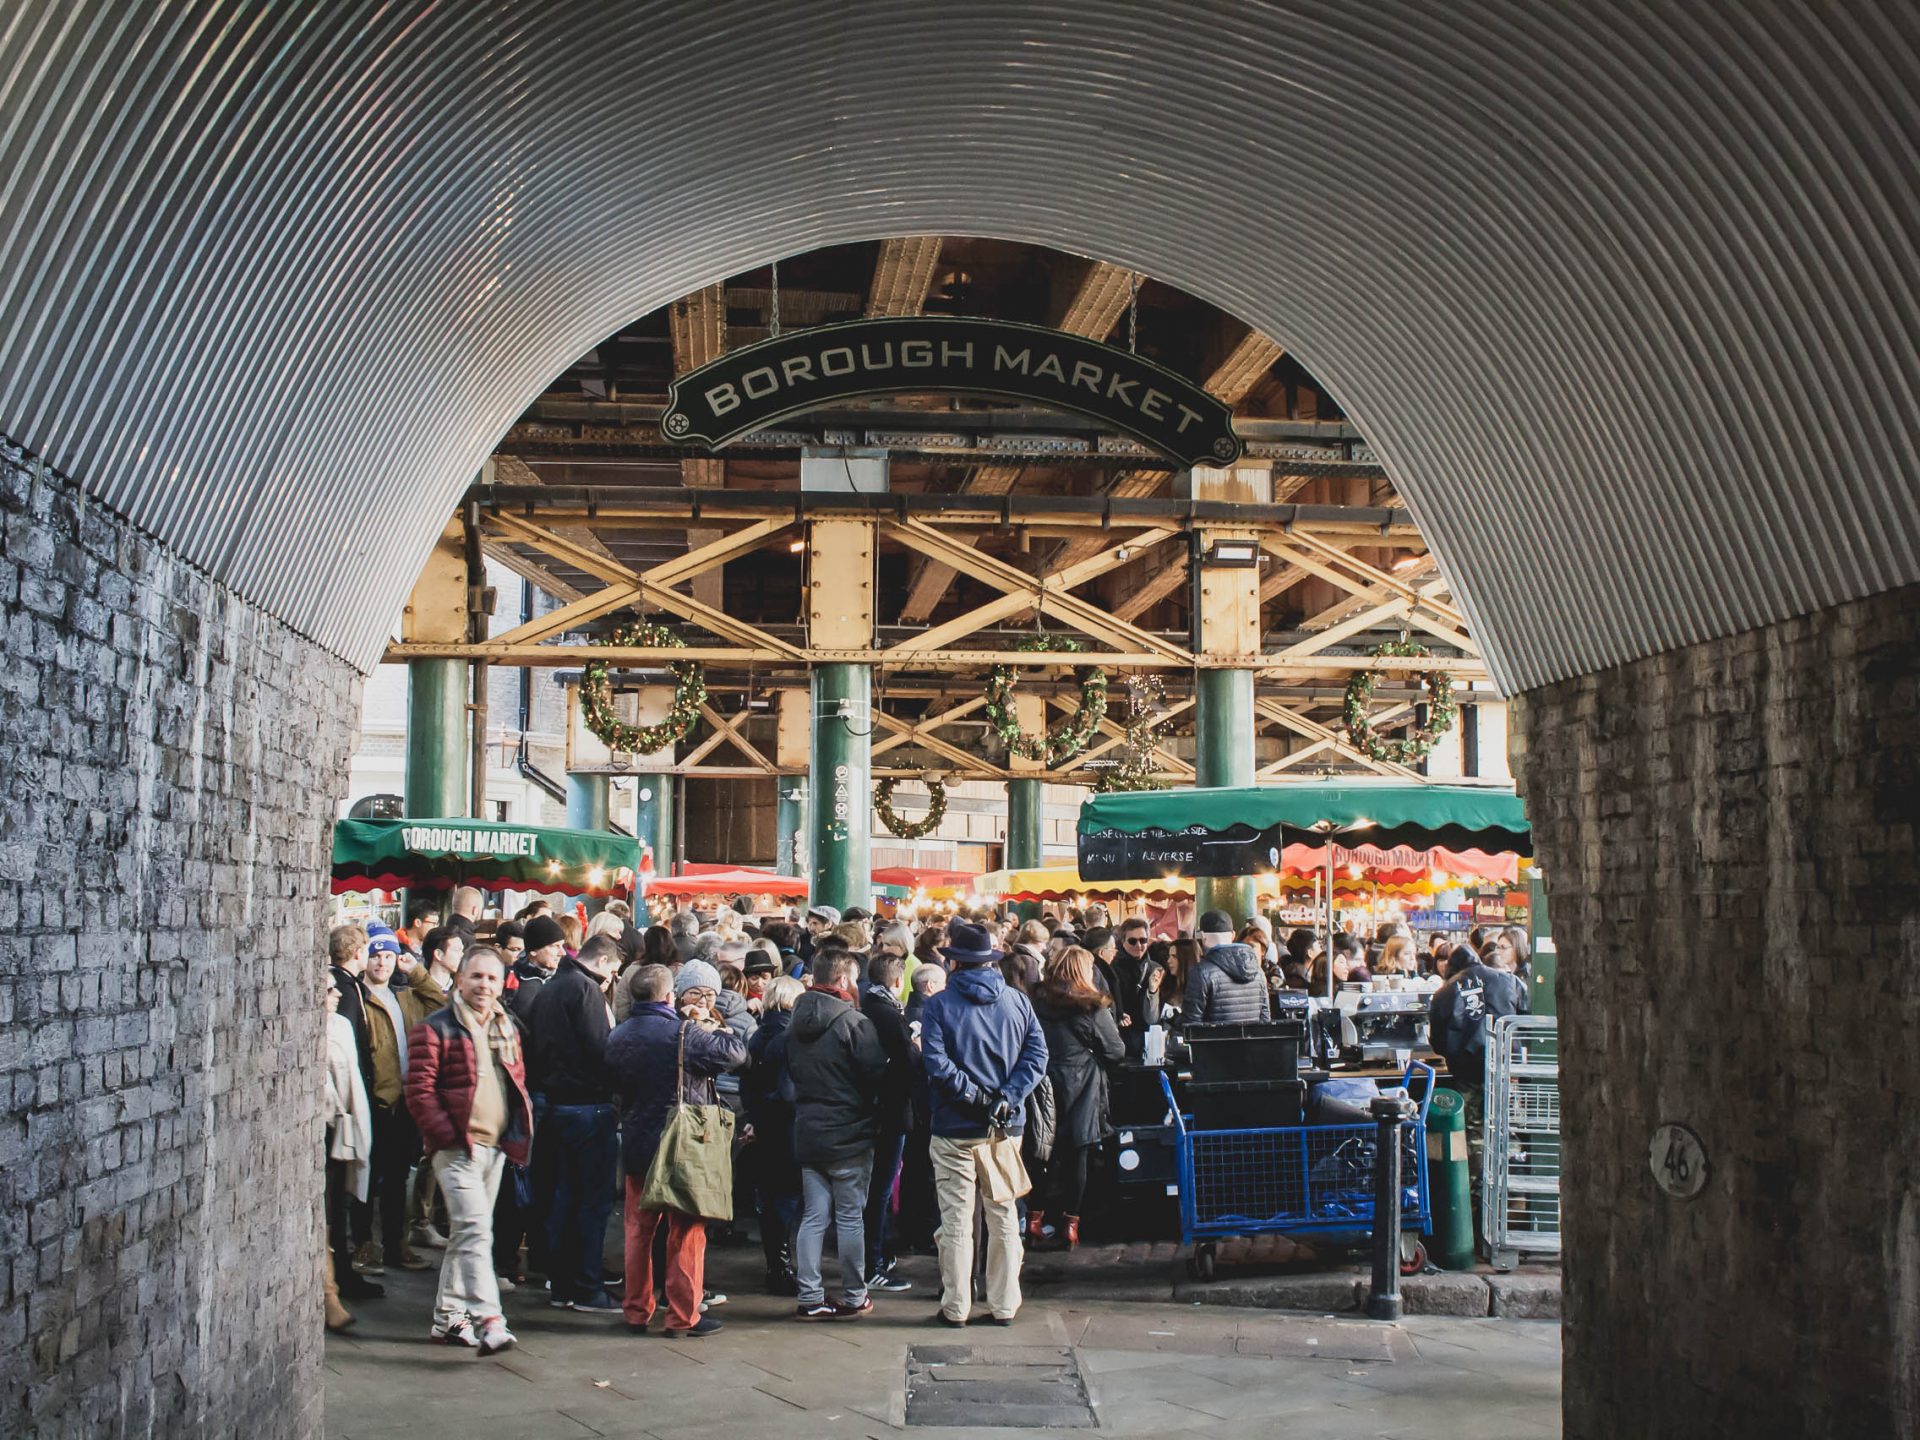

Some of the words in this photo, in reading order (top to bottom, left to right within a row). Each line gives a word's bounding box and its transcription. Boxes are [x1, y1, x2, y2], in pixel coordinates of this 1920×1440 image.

[704, 339, 975, 419] BOROUGH
[993, 344, 1204, 435] MARKET
[401, 826, 472, 853] BOROUGH
[473, 830, 539, 856] MARKET
[1086, 853, 1116, 864] MNU
[1663, 1142, 1690, 1181] 46
